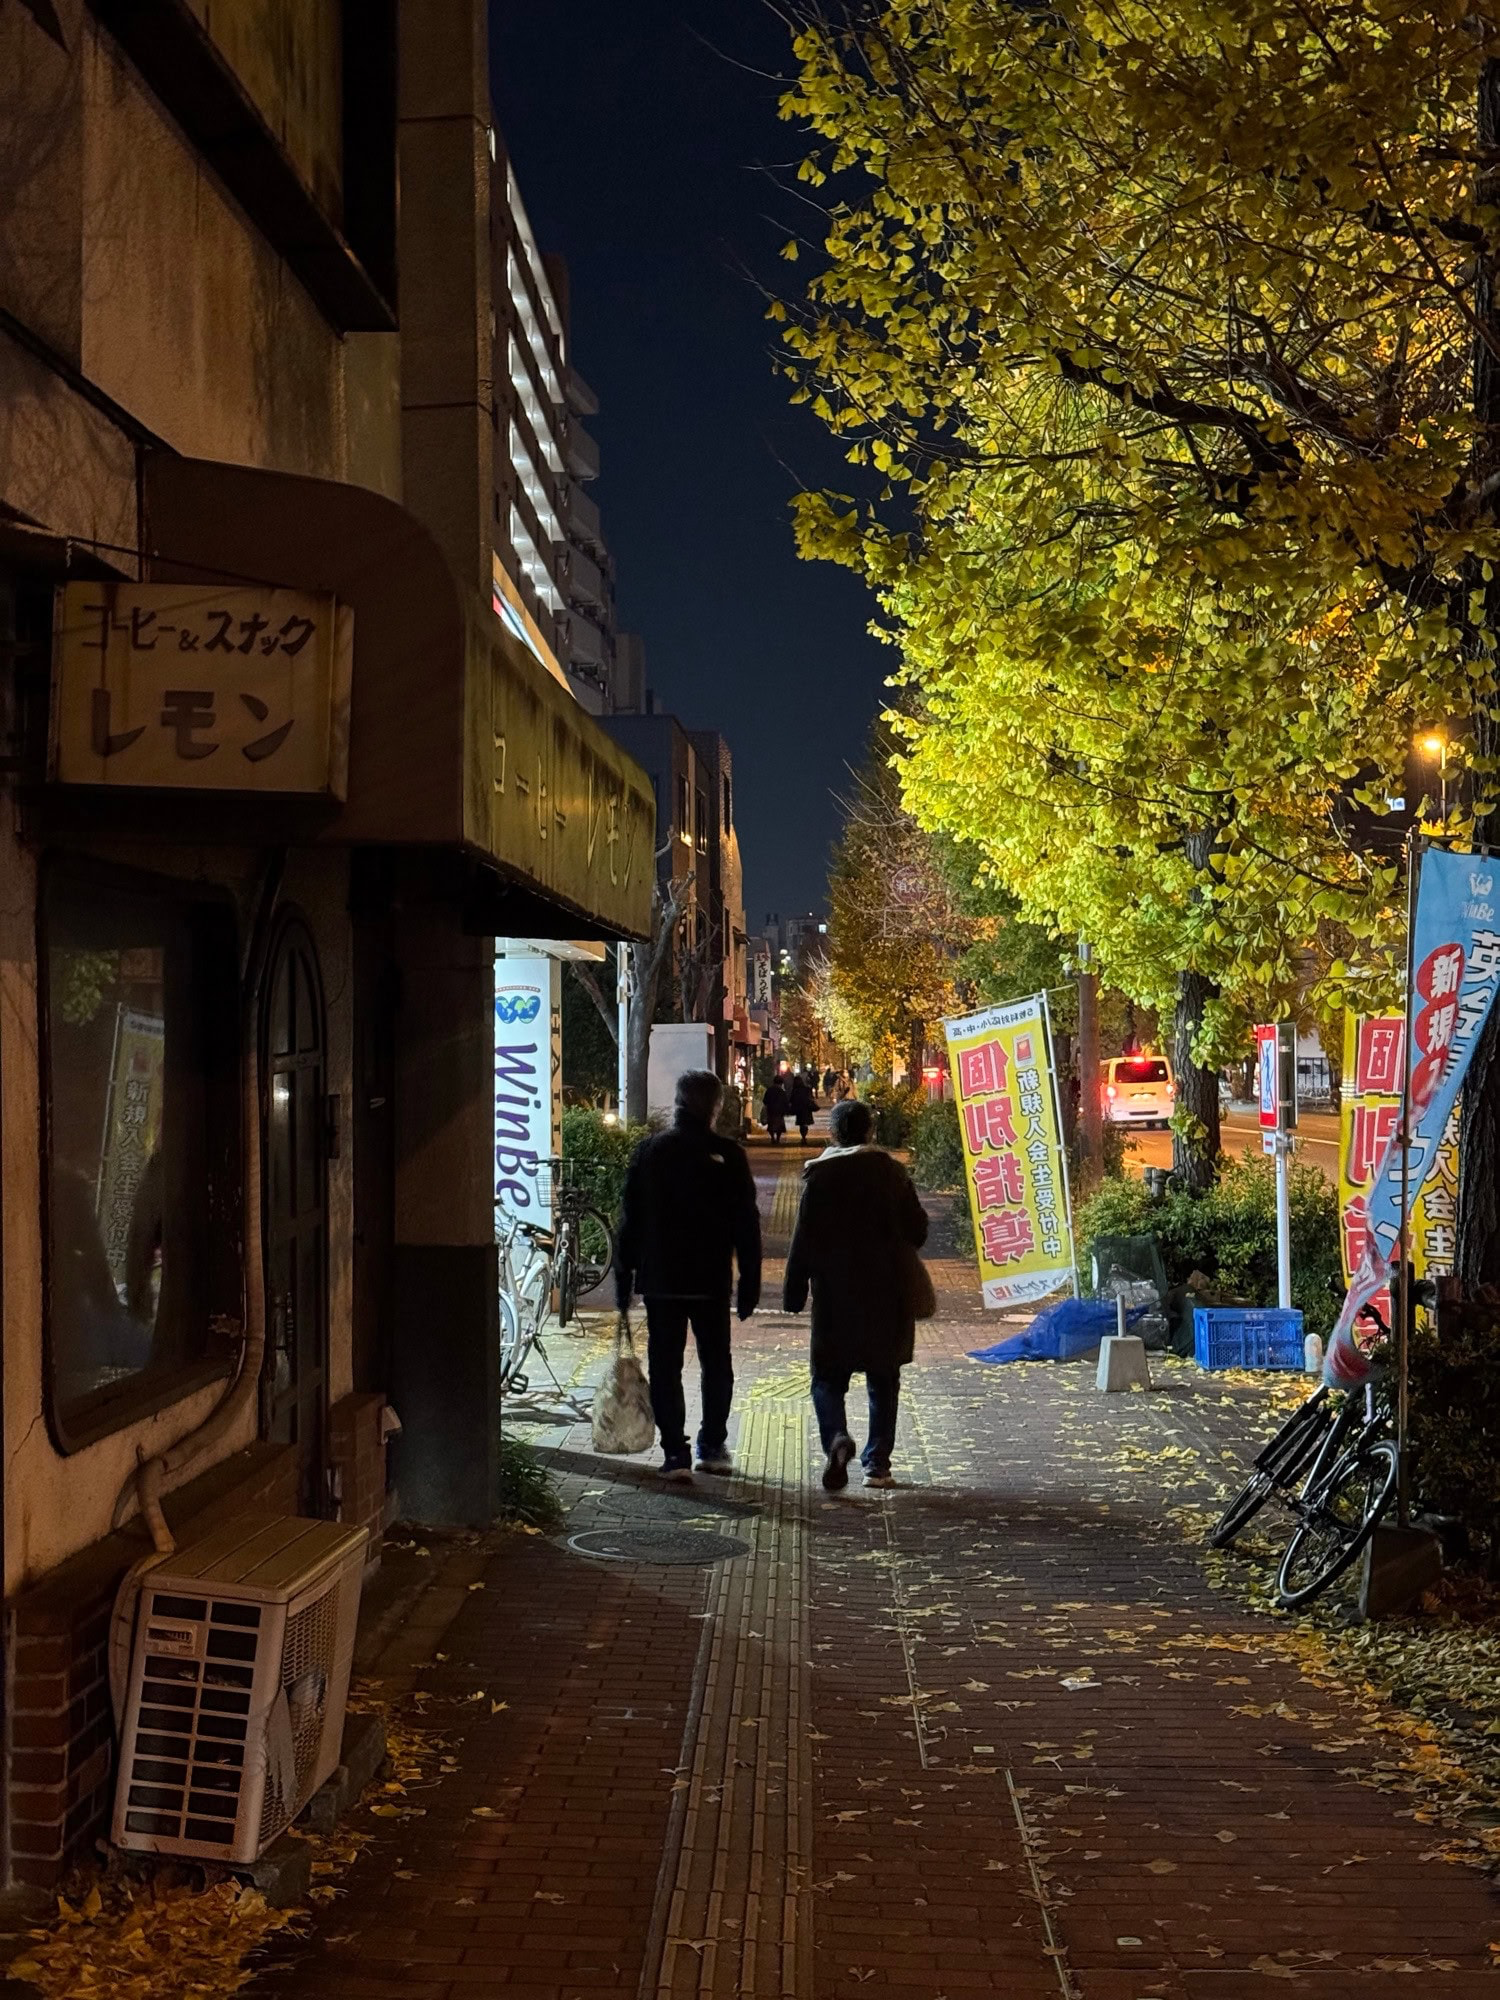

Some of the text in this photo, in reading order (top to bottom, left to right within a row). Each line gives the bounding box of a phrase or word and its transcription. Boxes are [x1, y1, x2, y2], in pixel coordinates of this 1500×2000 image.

[92, 688, 295, 763] レモン
[495, 1042, 541, 1208] WinBe
